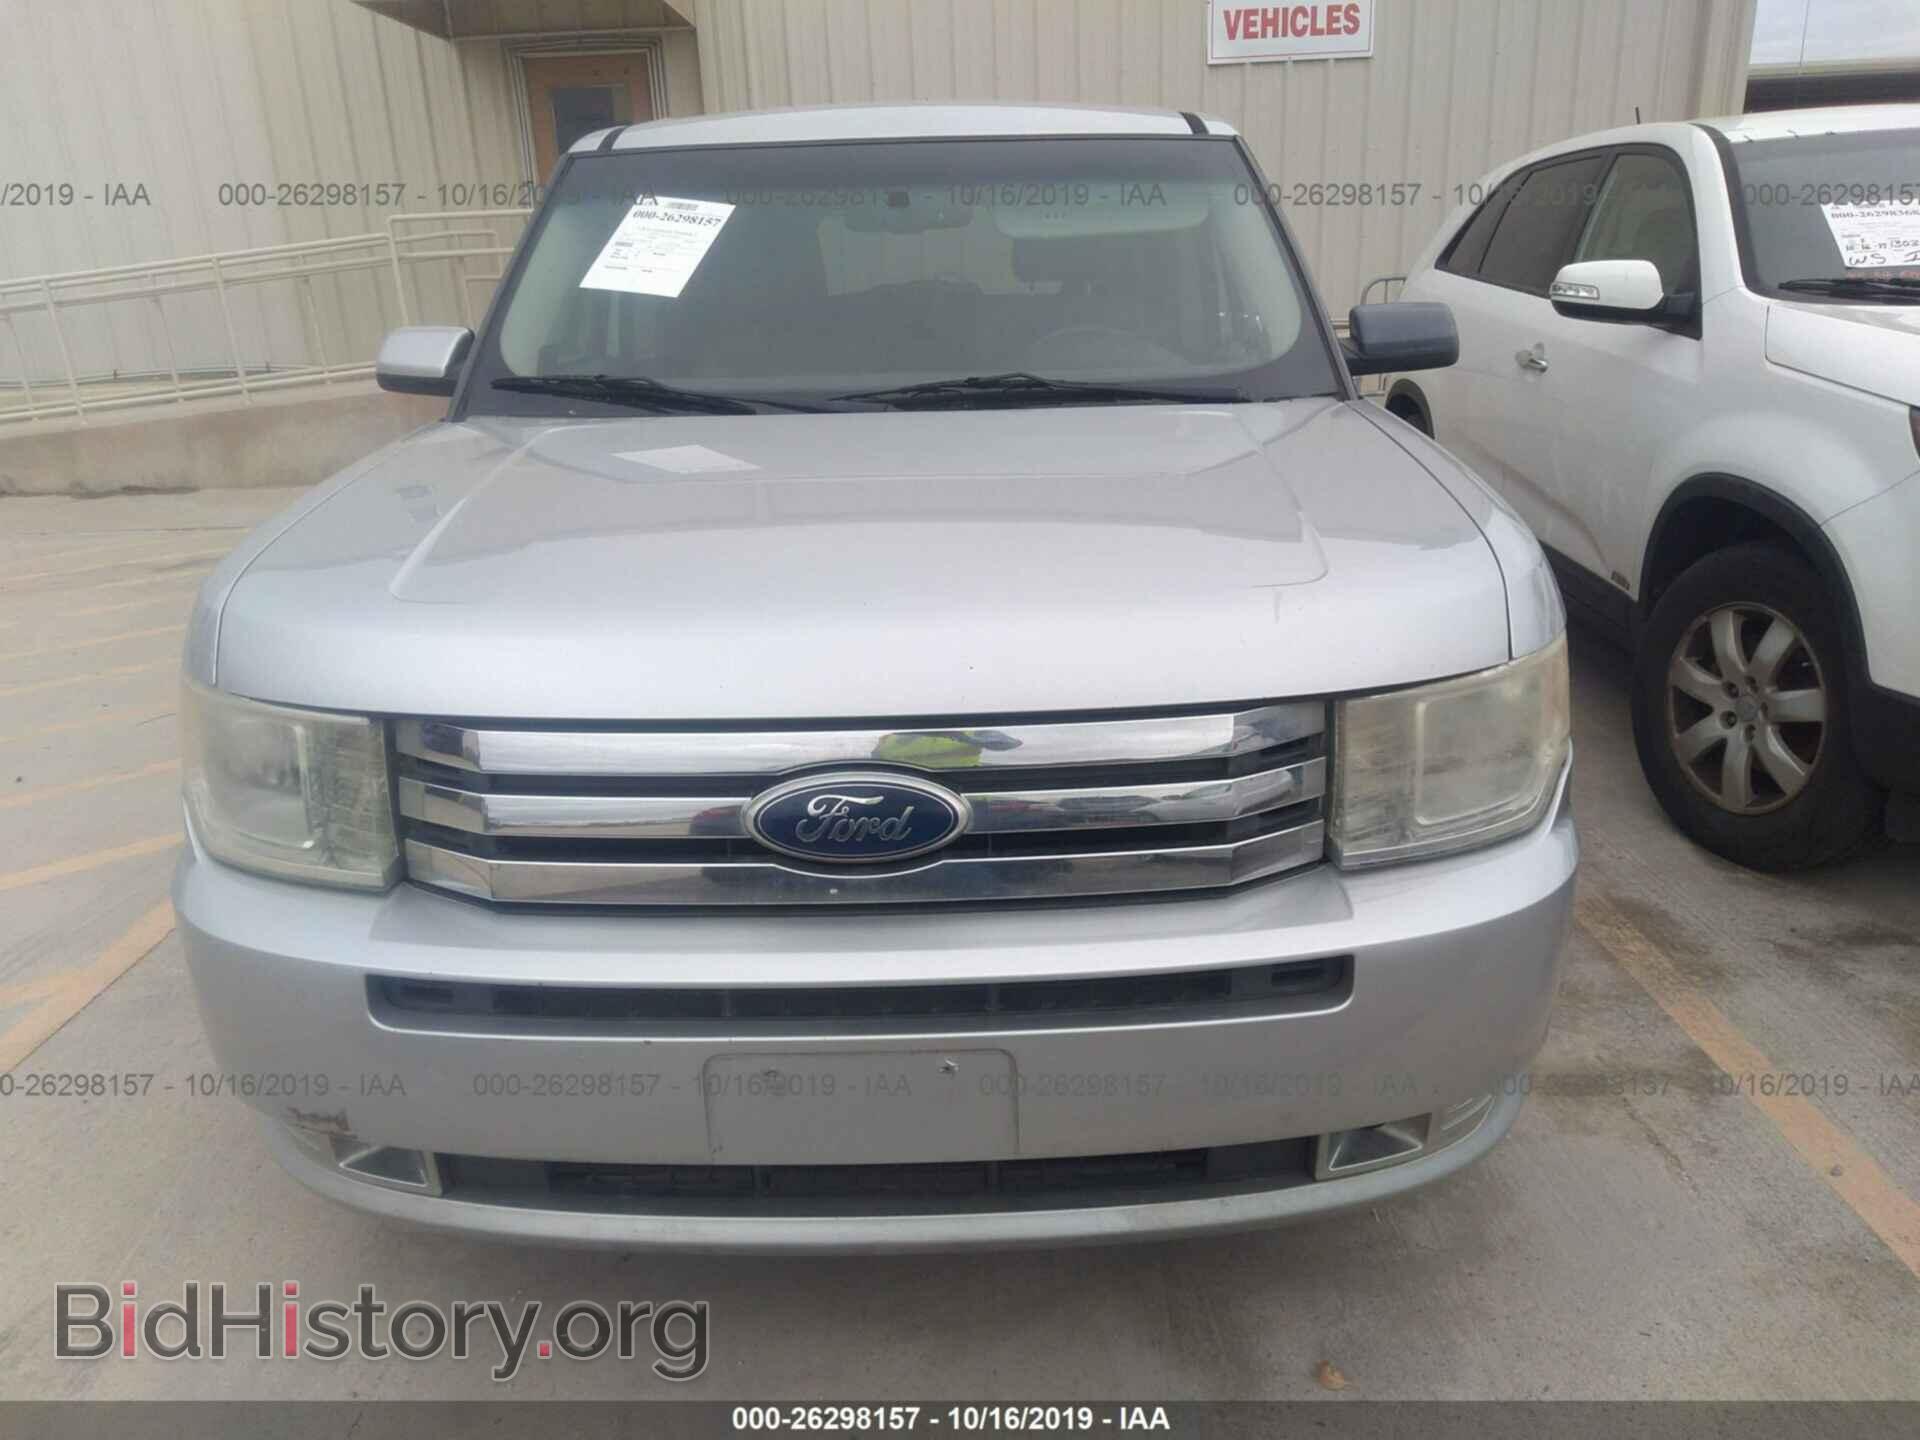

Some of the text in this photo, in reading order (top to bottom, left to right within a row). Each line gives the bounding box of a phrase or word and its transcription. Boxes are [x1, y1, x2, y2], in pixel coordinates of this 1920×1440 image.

[1223, 3, 1360, 41] VEHICLES
[632, 209, 722, 228] 000-26298157
[795, 793, 915, 843] Ford
